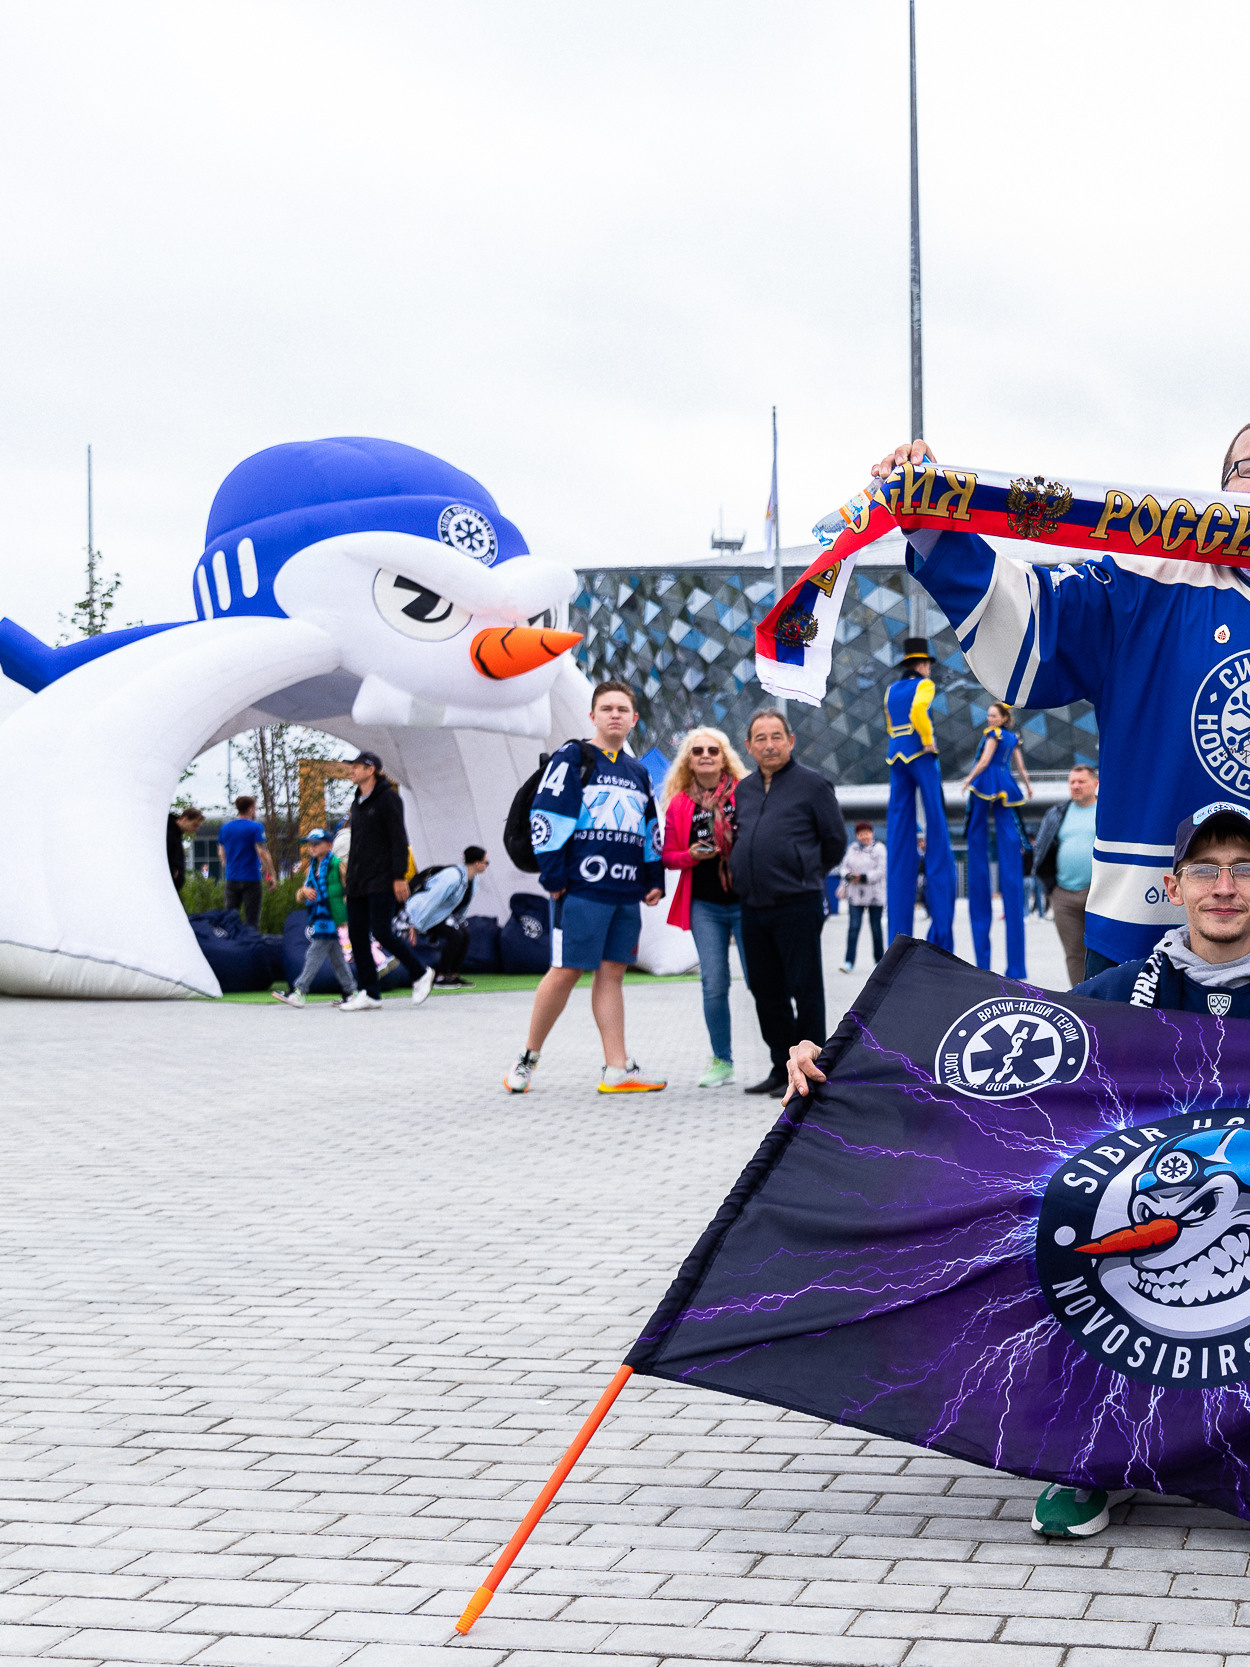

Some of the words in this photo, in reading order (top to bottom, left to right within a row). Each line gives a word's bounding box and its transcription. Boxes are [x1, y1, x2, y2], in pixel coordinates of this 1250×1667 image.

[596, 774, 637, 790] СИБИРЬ
[610, 863, 638, 881] СГК
[1052, 1013, 1080, 1043] ГЕРОИ
[1062, 1126, 1168, 1194] SIBIR
